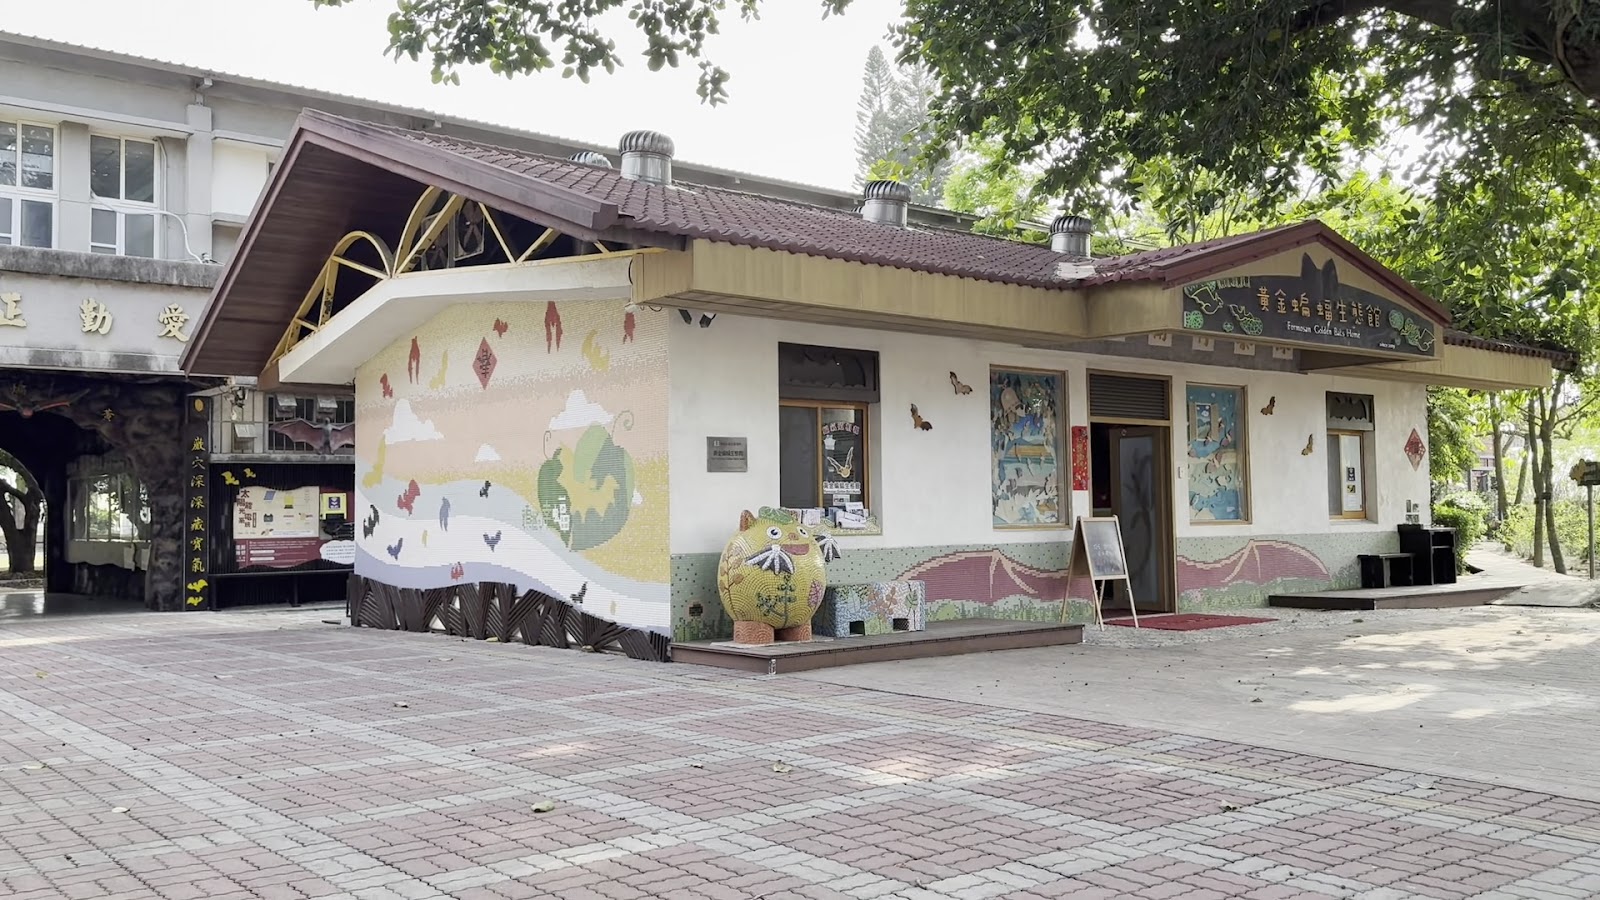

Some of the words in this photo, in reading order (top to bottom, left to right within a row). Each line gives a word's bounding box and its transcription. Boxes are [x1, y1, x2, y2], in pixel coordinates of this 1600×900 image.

[1257, 286, 1382, 328] 黃金蝙蝠生態館
